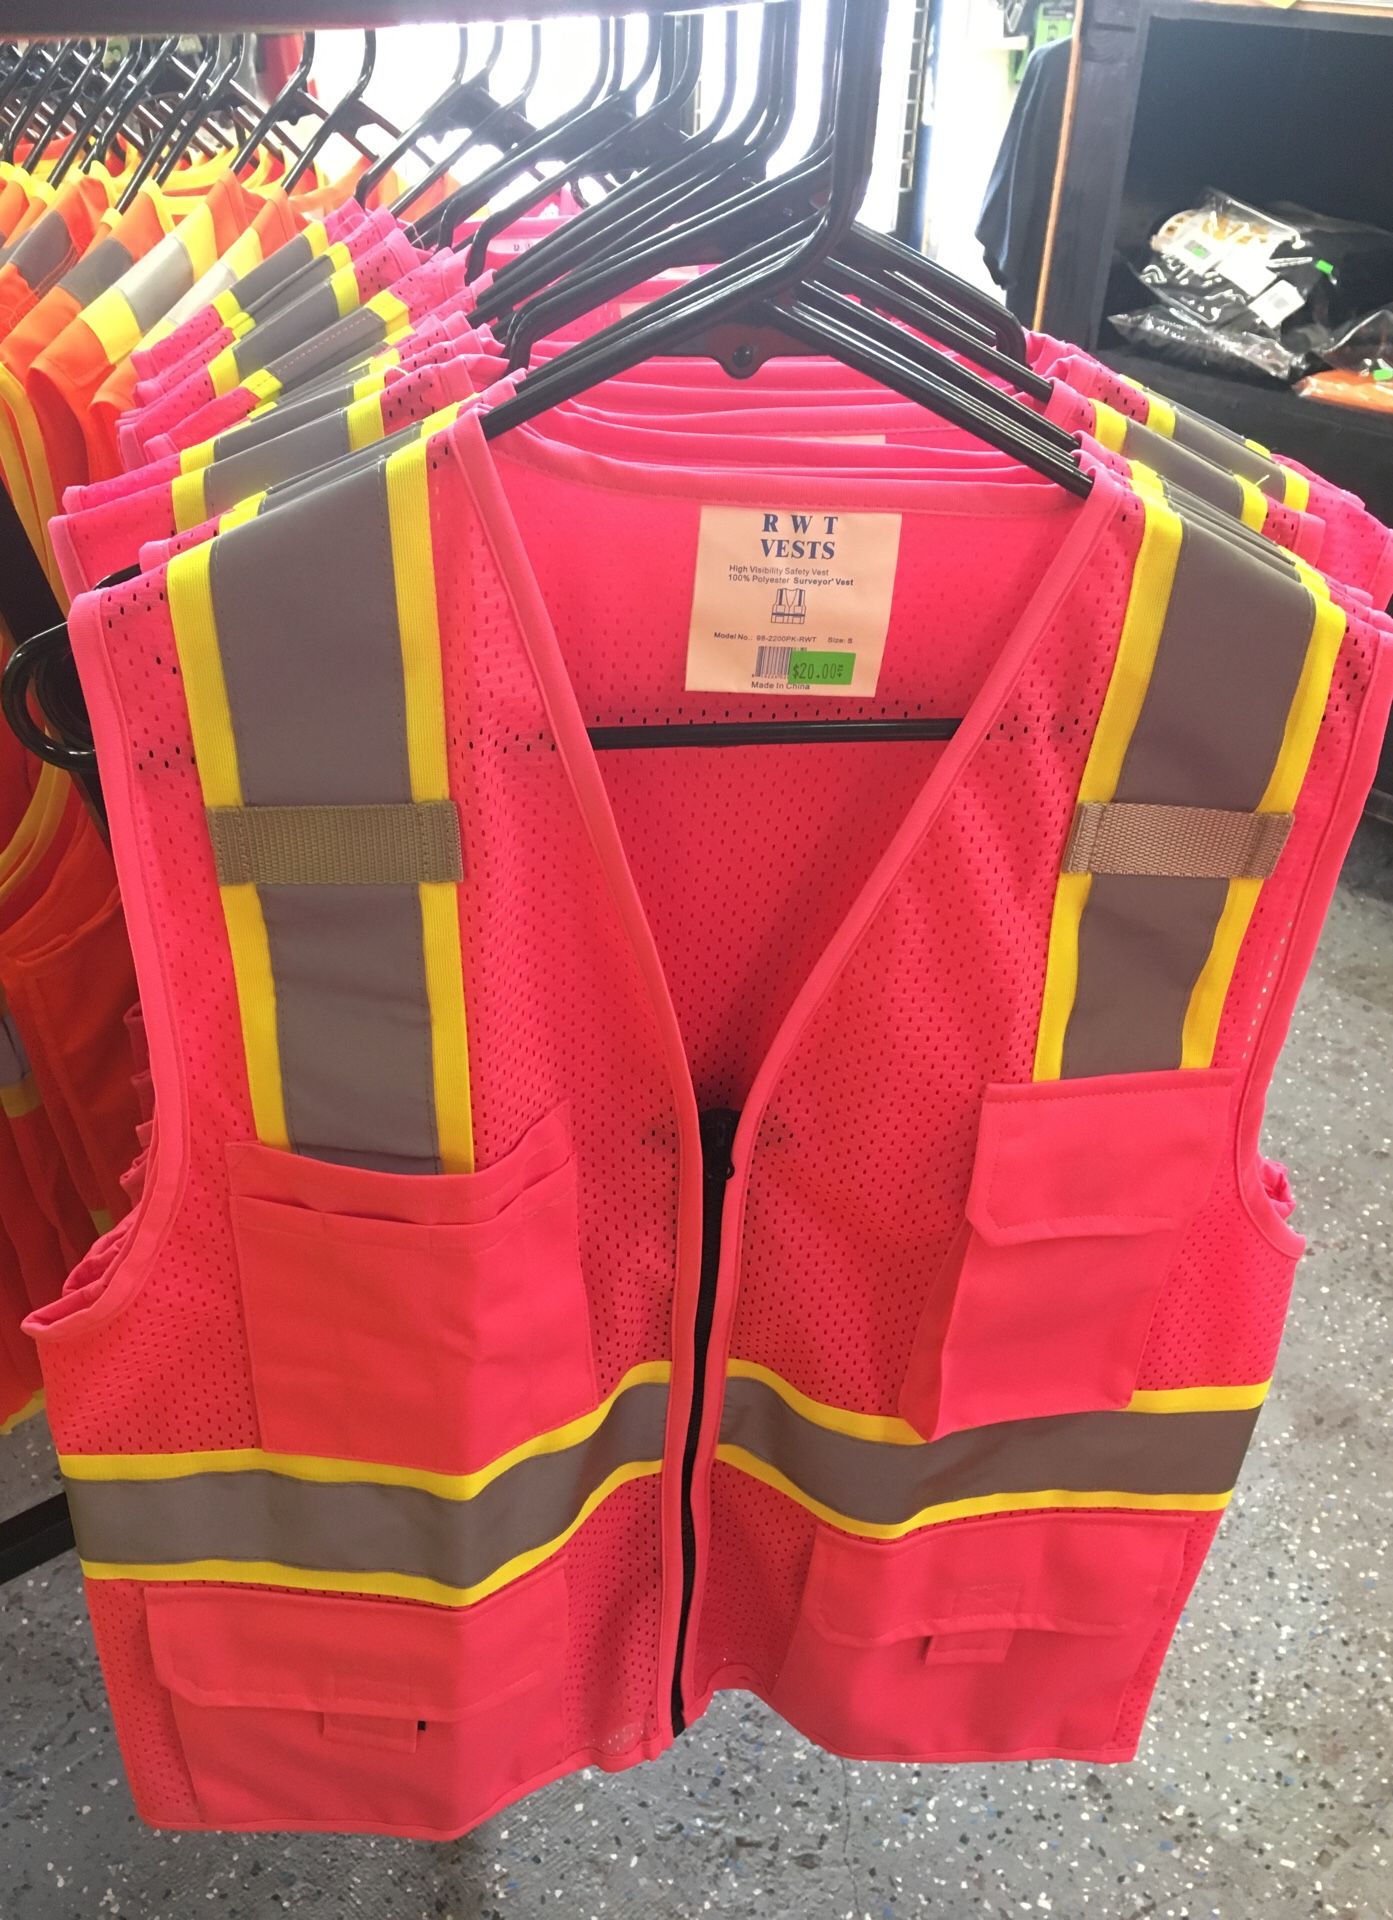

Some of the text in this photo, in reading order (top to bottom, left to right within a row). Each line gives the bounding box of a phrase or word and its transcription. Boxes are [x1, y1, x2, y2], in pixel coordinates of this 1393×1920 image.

[760, 539, 835, 560] VESTS
[729, 565, 829, 577] High Visibility Safety Vest
[728, 574, 750, 582] 100%
[752, 575, 790, 584] Polyester
[835, 578, 854, 586] Vest
[714, 632, 737, 640] Model
[793, 662, 837, 680] $20.00
[751, 681, 775, 689] Made
